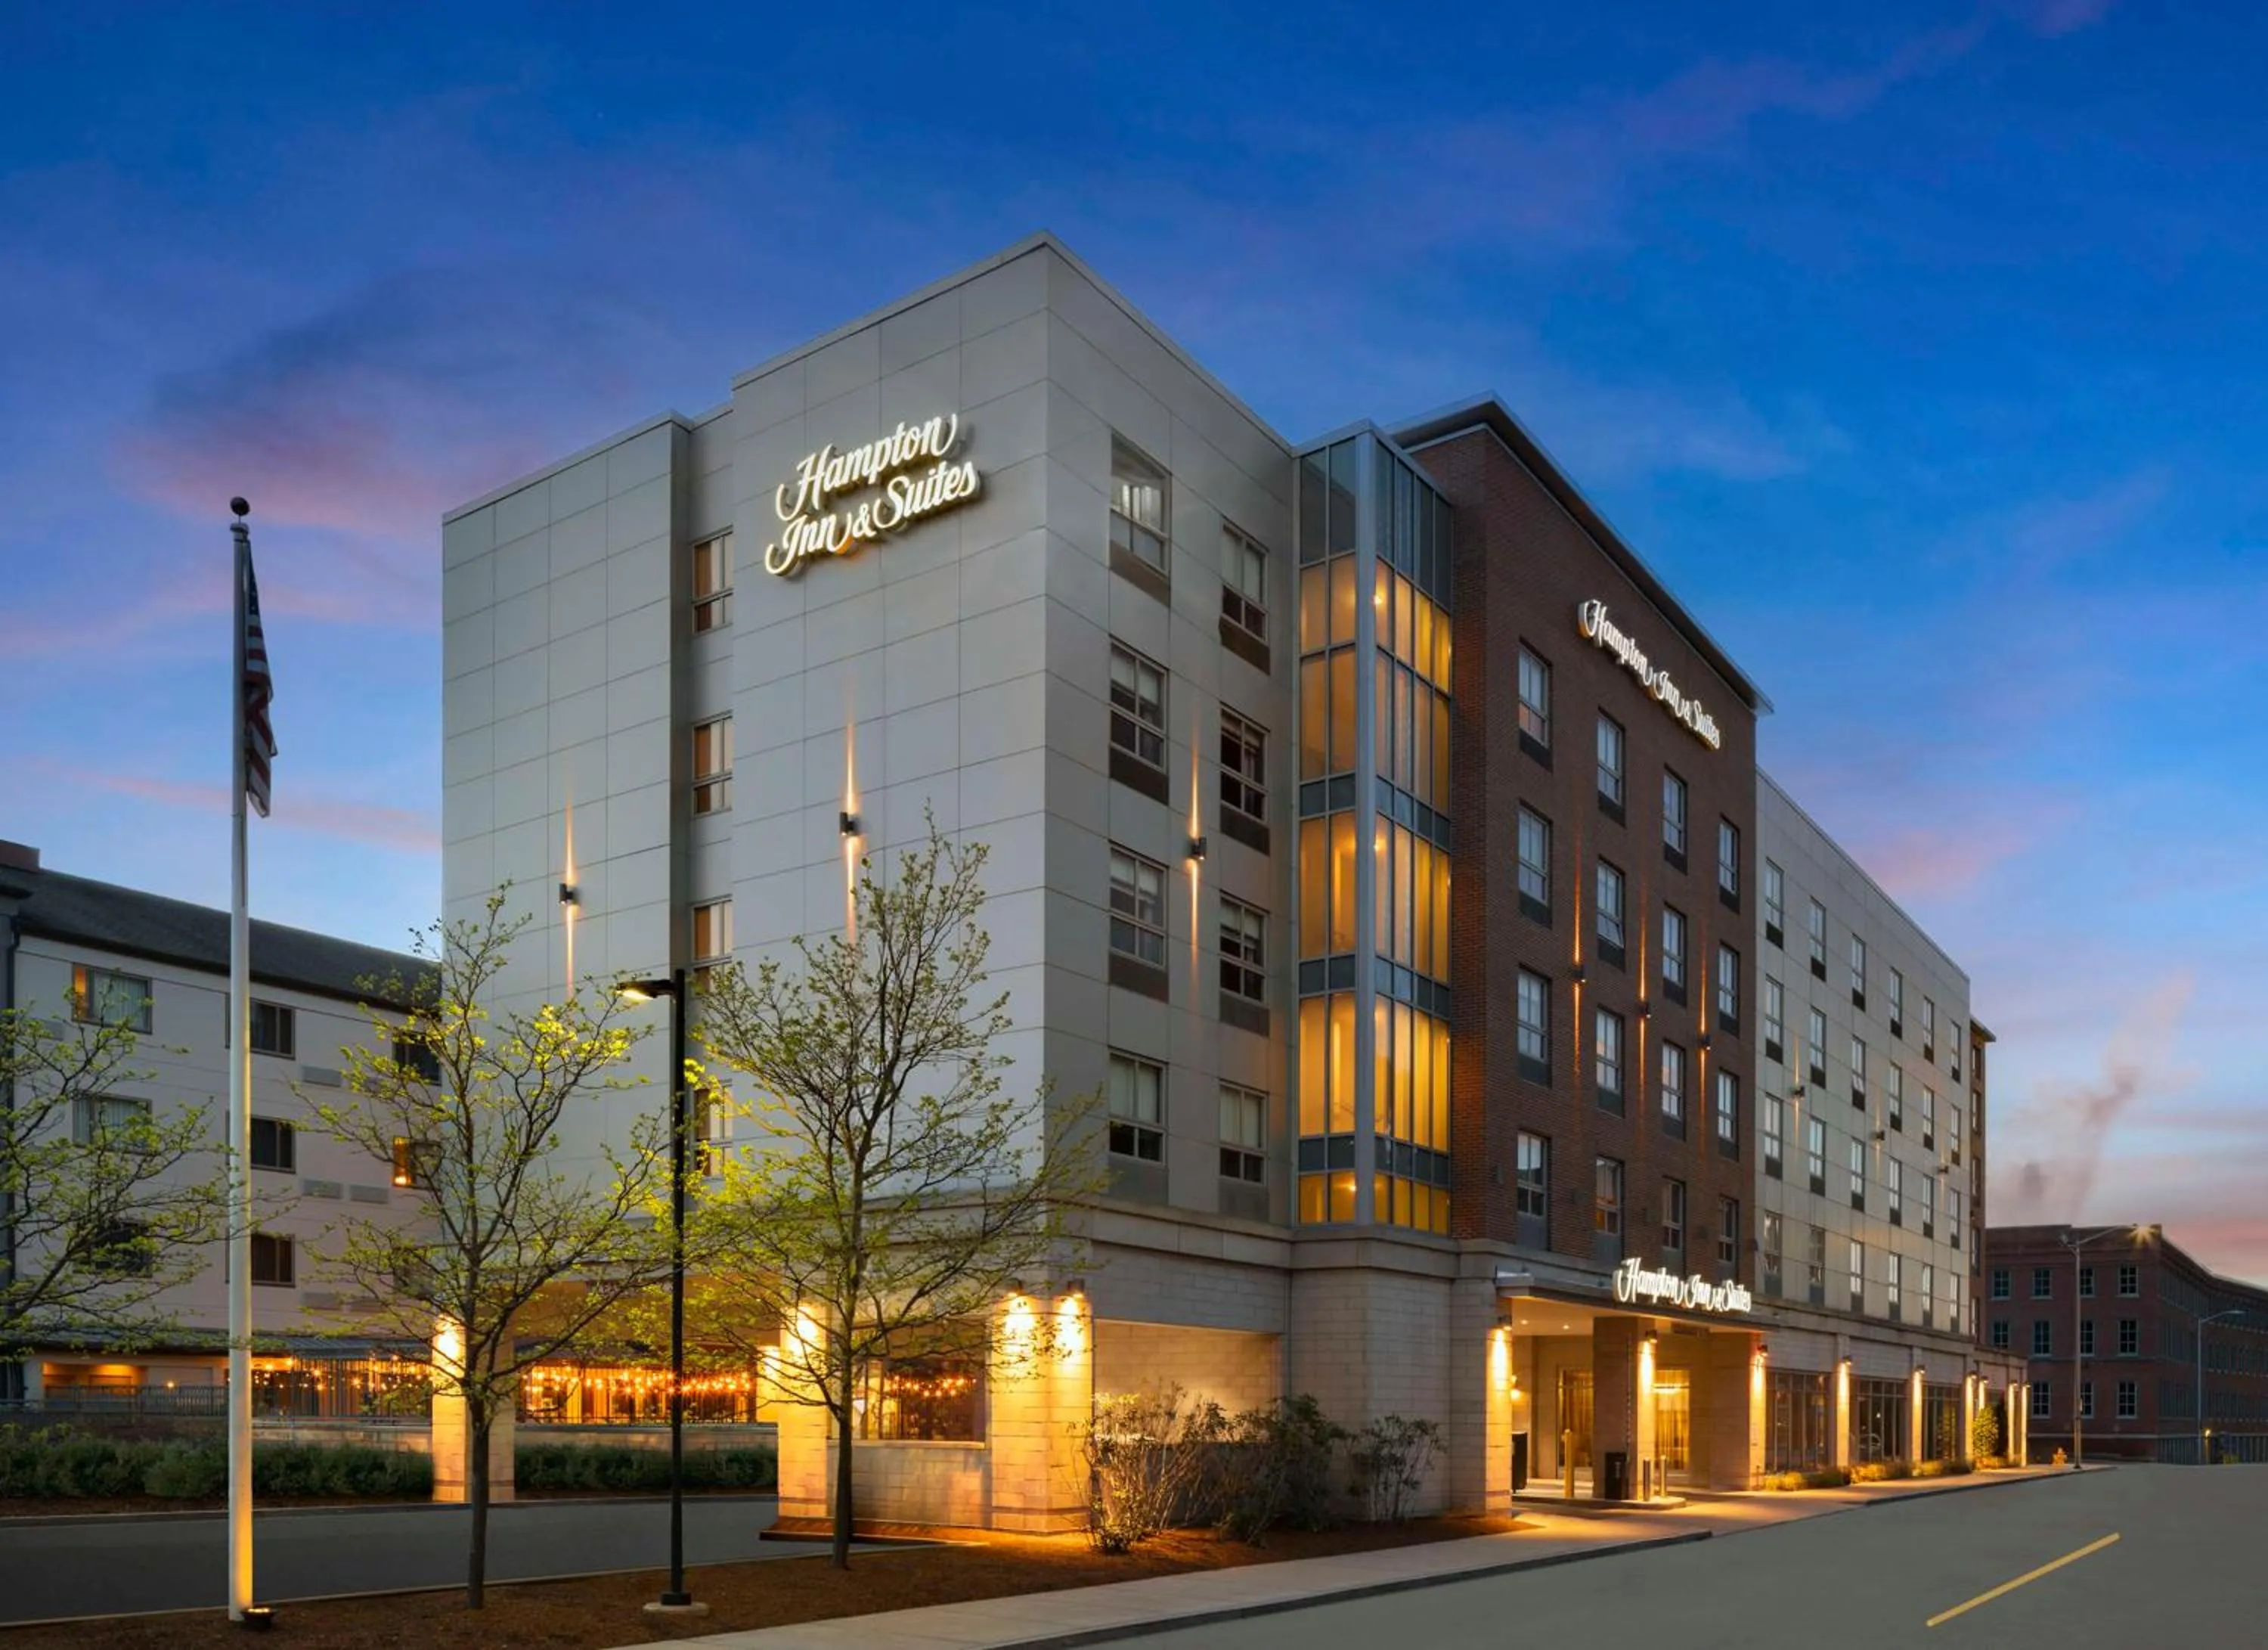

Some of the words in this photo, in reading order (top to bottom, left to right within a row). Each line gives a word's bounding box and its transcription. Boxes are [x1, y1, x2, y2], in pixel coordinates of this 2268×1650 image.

[765, 514, 852, 575] Inn
[852, 503, 877, 538] &
[873, 461, 977, 529] Suites
[776, 414, 958, 521] Hampton
[1585, 599, 1653, 686] Hampton
[1653, 671, 1685, 718] Inn
[1693, 700, 1720, 749] Suites
[1617, 1257, 1684, 1304] Hampton
[1684, 1274, 1716, 1311] Inn
[1723, 1280, 1752, 1313] Suites
